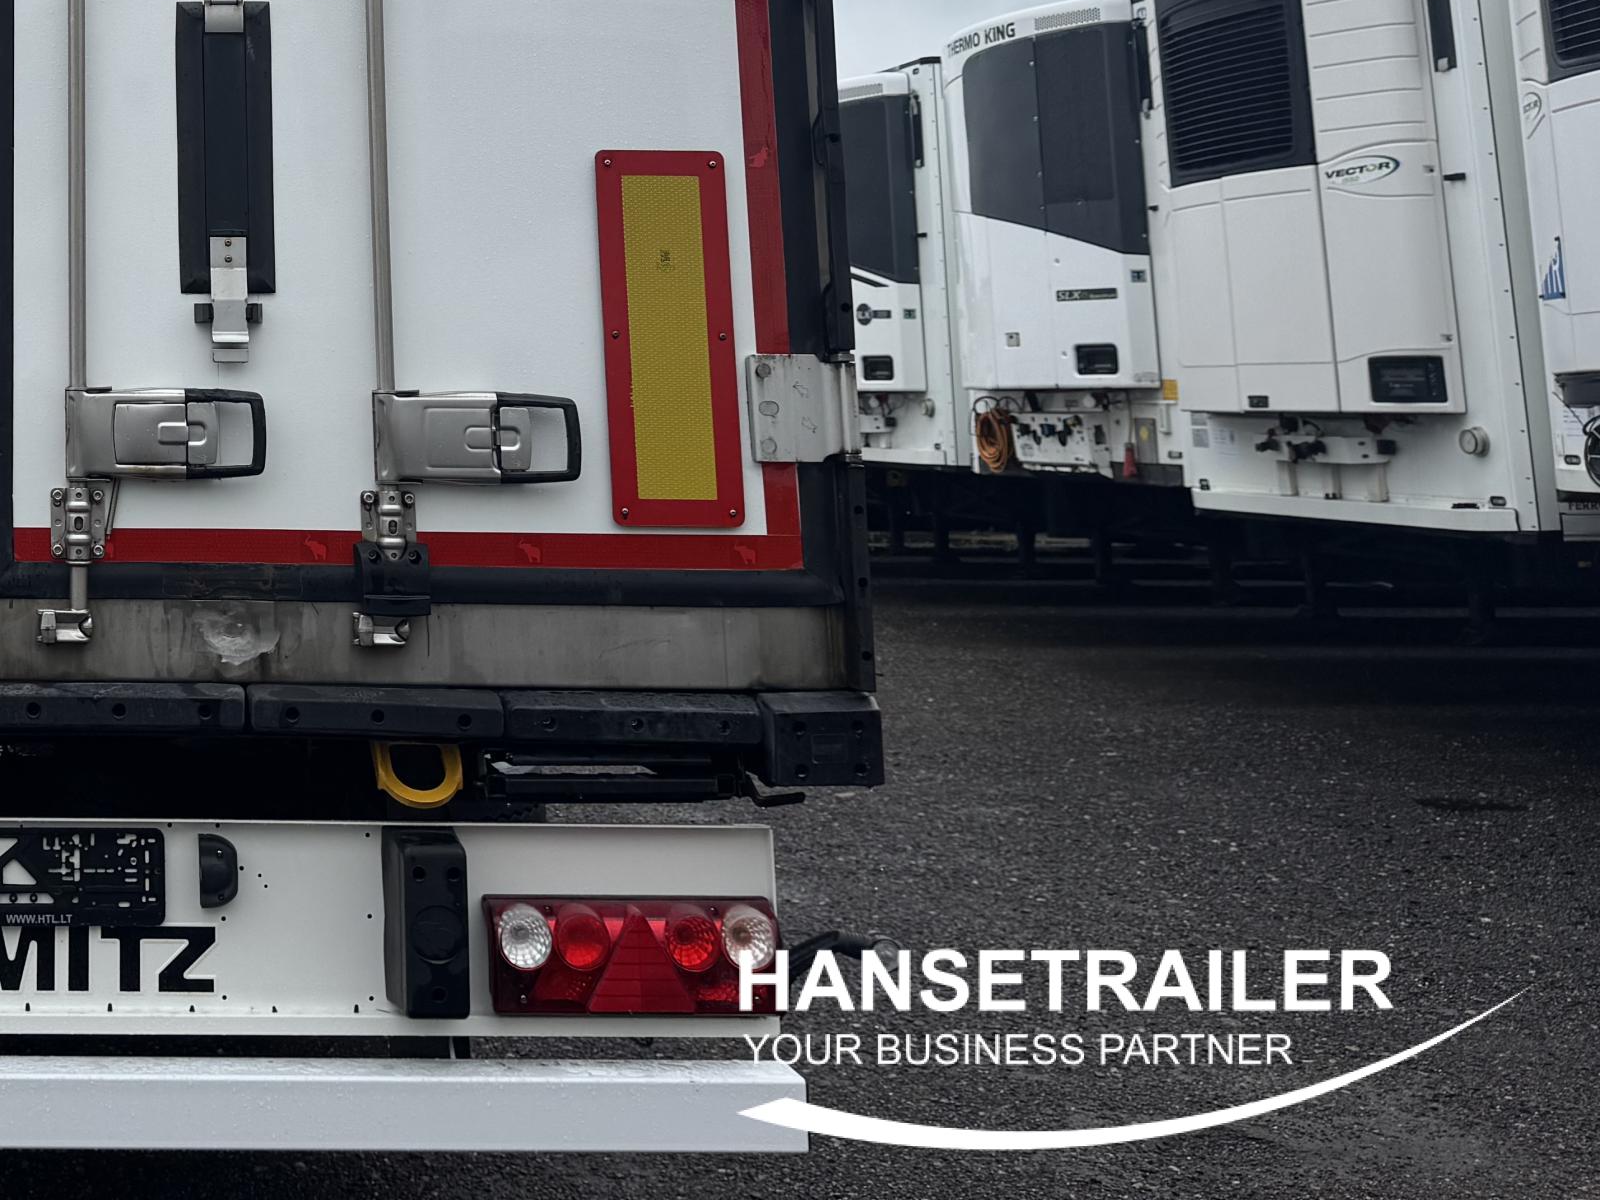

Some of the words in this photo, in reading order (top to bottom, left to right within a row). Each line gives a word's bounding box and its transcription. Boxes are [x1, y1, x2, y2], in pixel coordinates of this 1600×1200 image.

[946, 32, 981, 58] THERMO
[984, 21, 1016, 44] KING
[1325, 161, 1391, 179] VECTOR
[6, 914, 72, 924] WWW.HTL.LT
